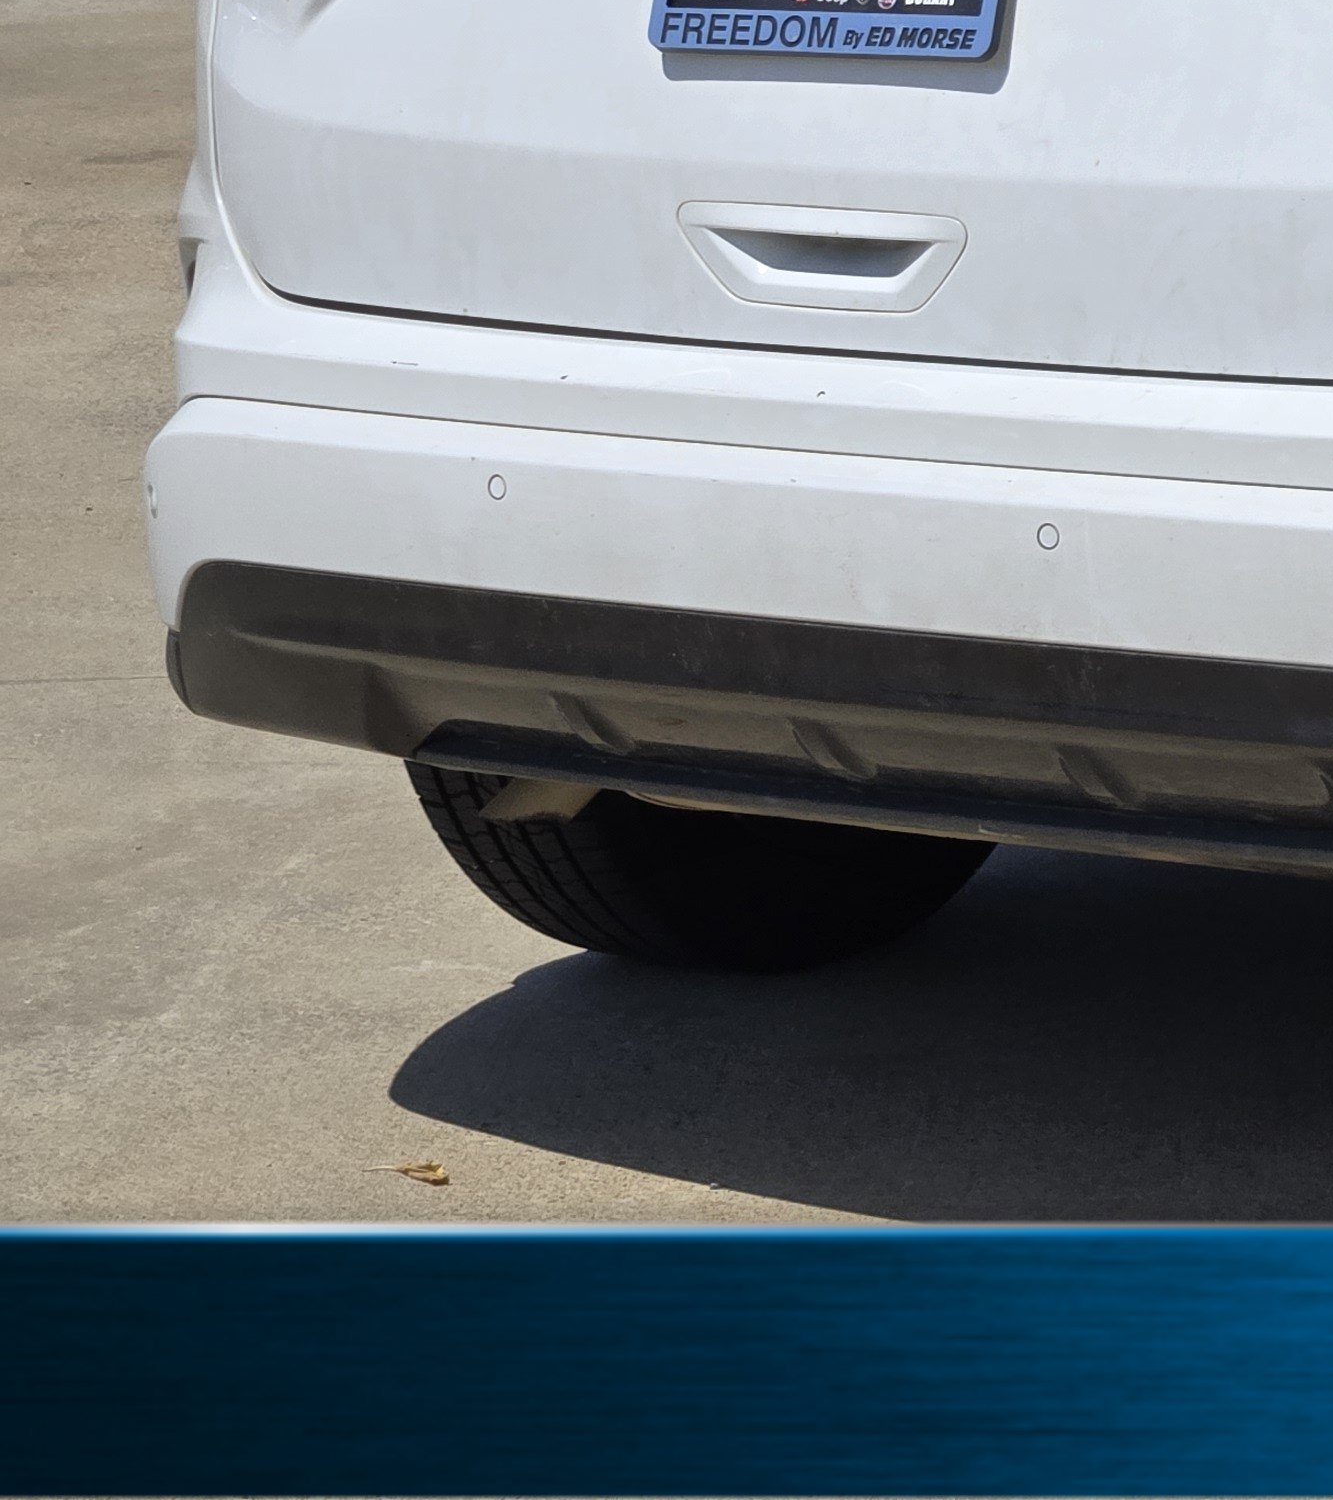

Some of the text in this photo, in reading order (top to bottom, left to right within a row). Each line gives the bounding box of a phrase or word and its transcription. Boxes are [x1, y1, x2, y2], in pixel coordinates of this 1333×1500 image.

[659, 12, 977, 51] FREEDOM By ED MORSE
